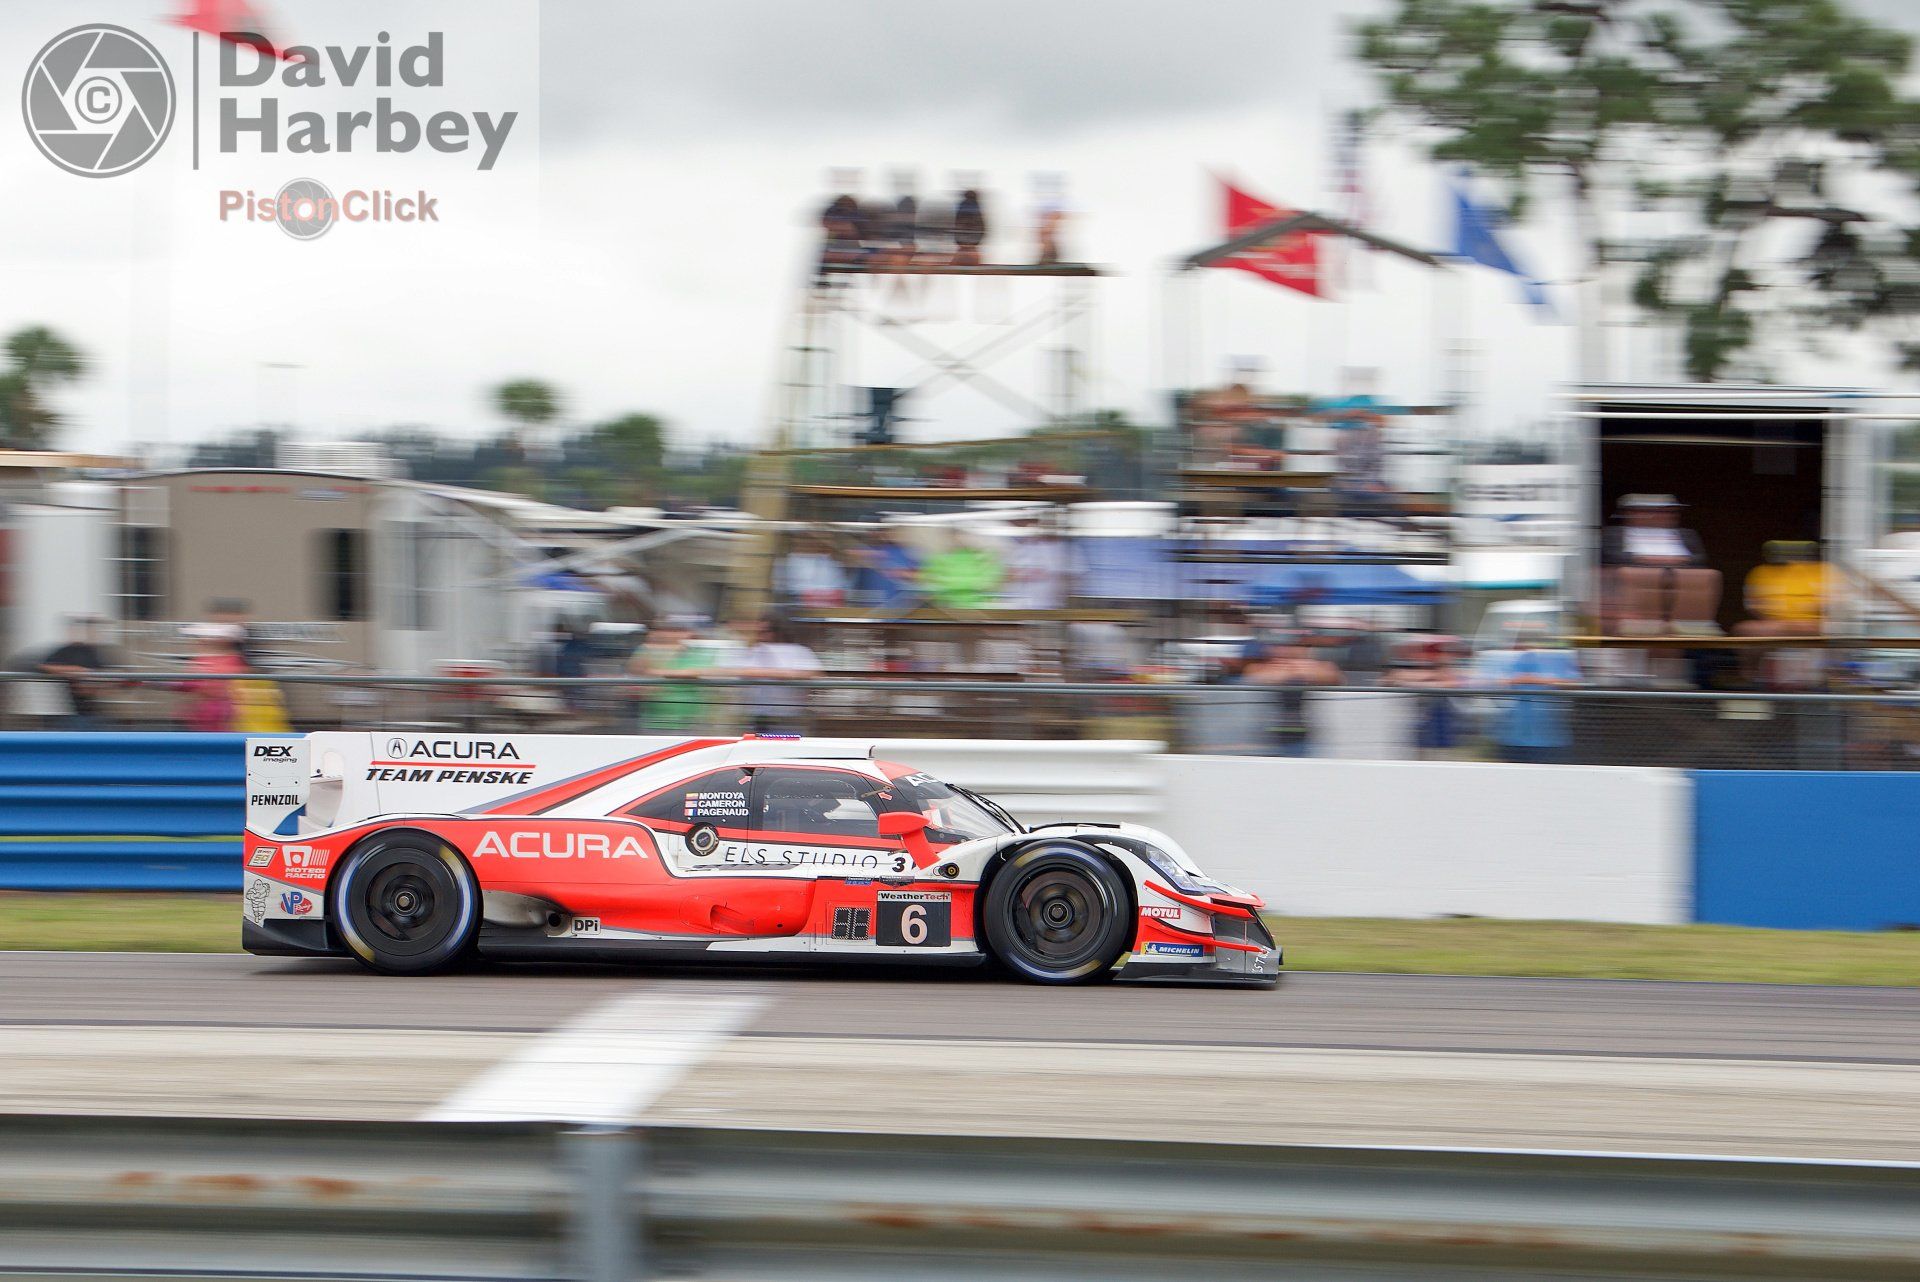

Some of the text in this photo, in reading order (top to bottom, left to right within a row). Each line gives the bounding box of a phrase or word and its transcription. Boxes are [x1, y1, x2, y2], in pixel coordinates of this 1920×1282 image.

[254, 746, 294, 757] DEX
[409, 740, 520, 760] ACURA
[365, 768, 534, 785] TEAM PENSKE
[251, 794, 300, 806] PENNZOIL
[699, 792, 745, 800] MONTOYA
[698, 800, 746, 808] CAMERON
[697, 808, 749, 816] PAGENAUD
[472, 831, 649, 859] ACURA
[724, 846, 767, 864] ELS
[880, 892, 948, 900] WeatherTech
[1140, 907, 1180, 918] MOTUL
[574, 919, 598, 931] DPi
[900, 904, 928, 945] 6
[1158, 946, 1200, 954] MICHELIN
